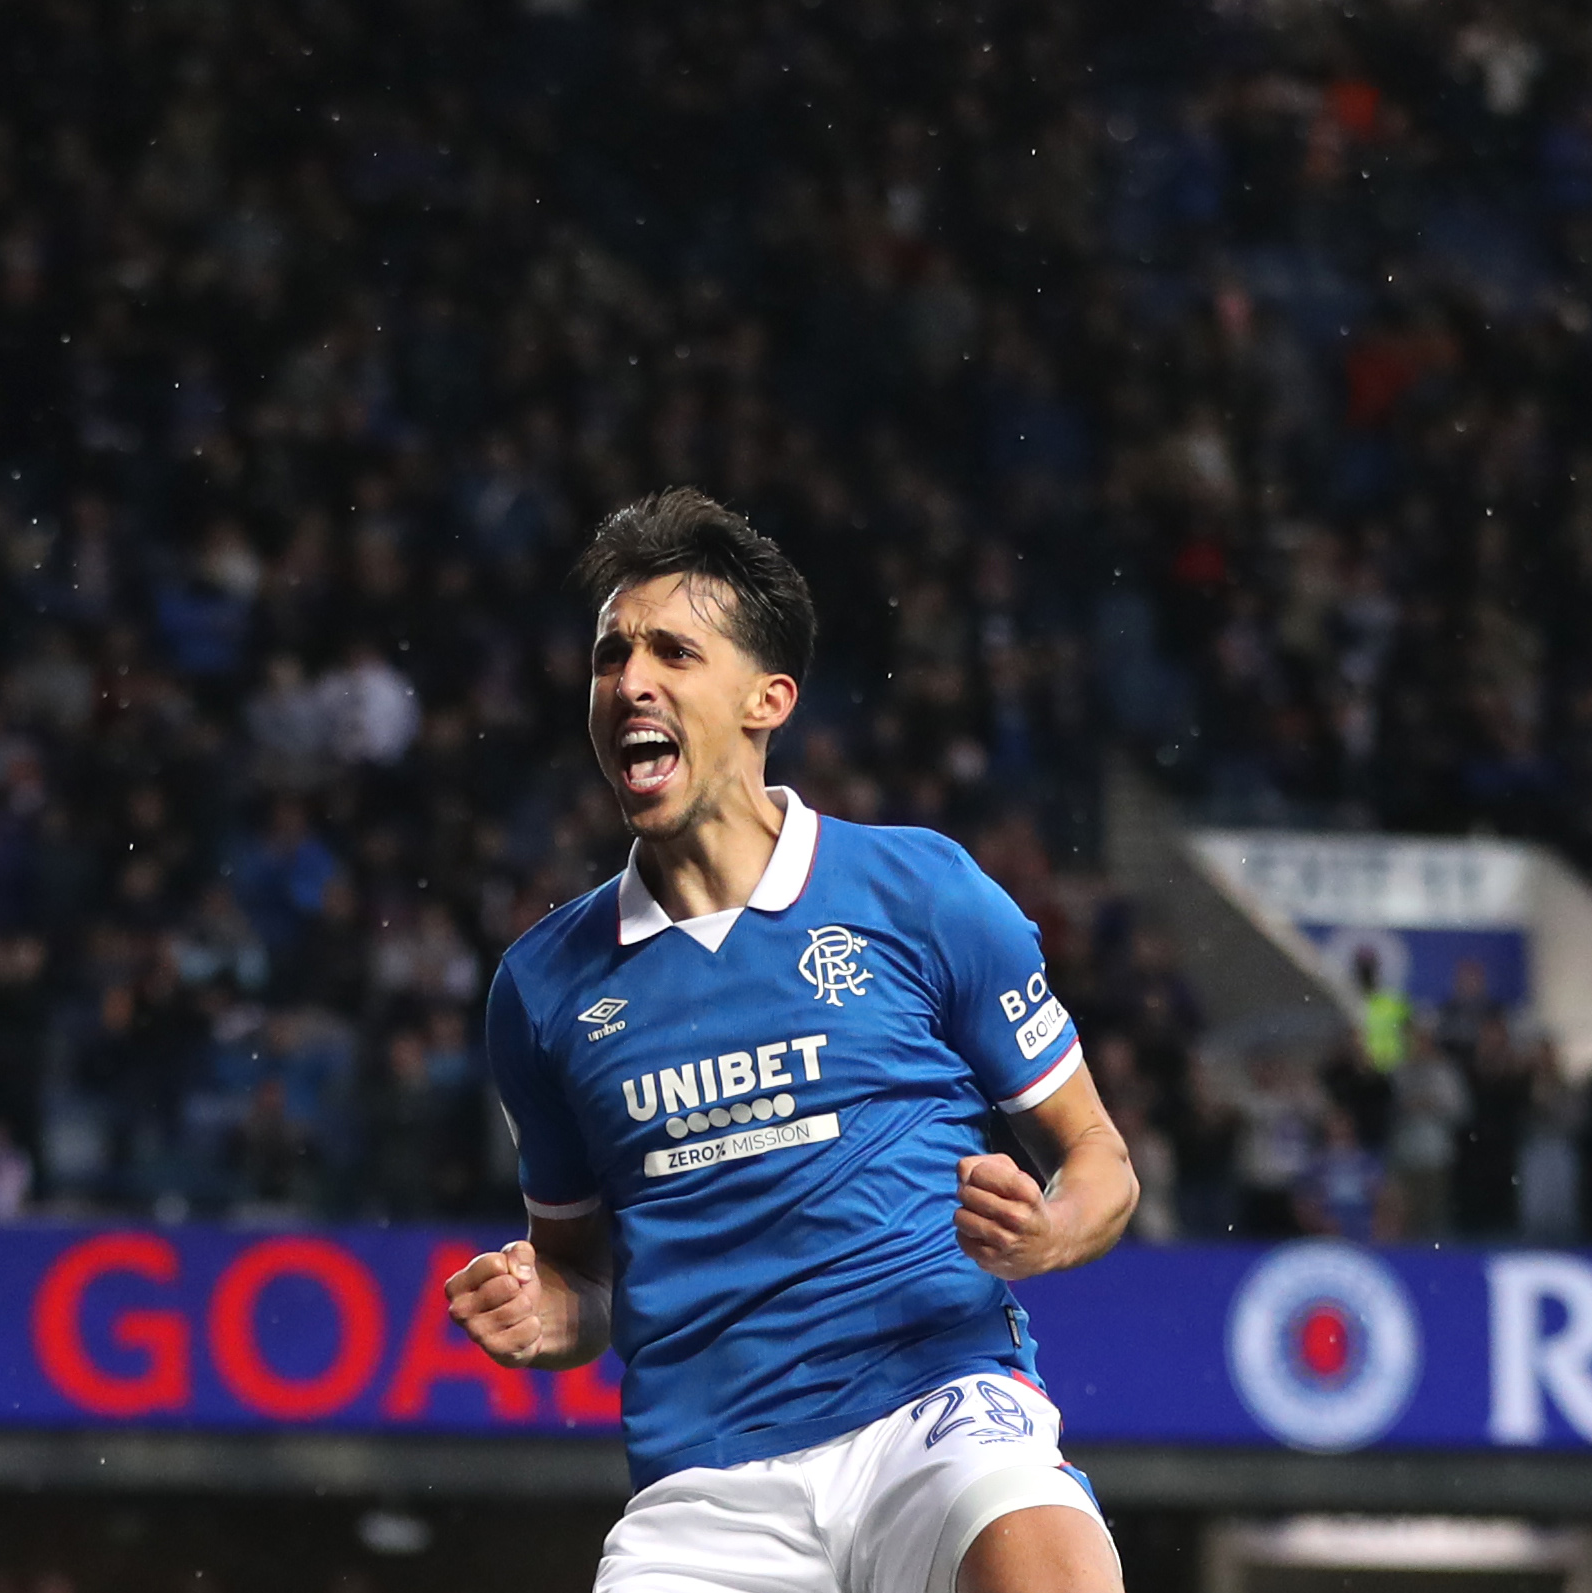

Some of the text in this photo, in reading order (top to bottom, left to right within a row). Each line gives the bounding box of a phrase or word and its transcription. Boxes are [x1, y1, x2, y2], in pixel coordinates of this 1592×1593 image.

[999, 962, 1047, 1023] BO
[587, 1019, 626, 1043] umbro
[621, 1033, 829, 1123] UNIBET
[732, 1122, 811, 1155] MISSION
